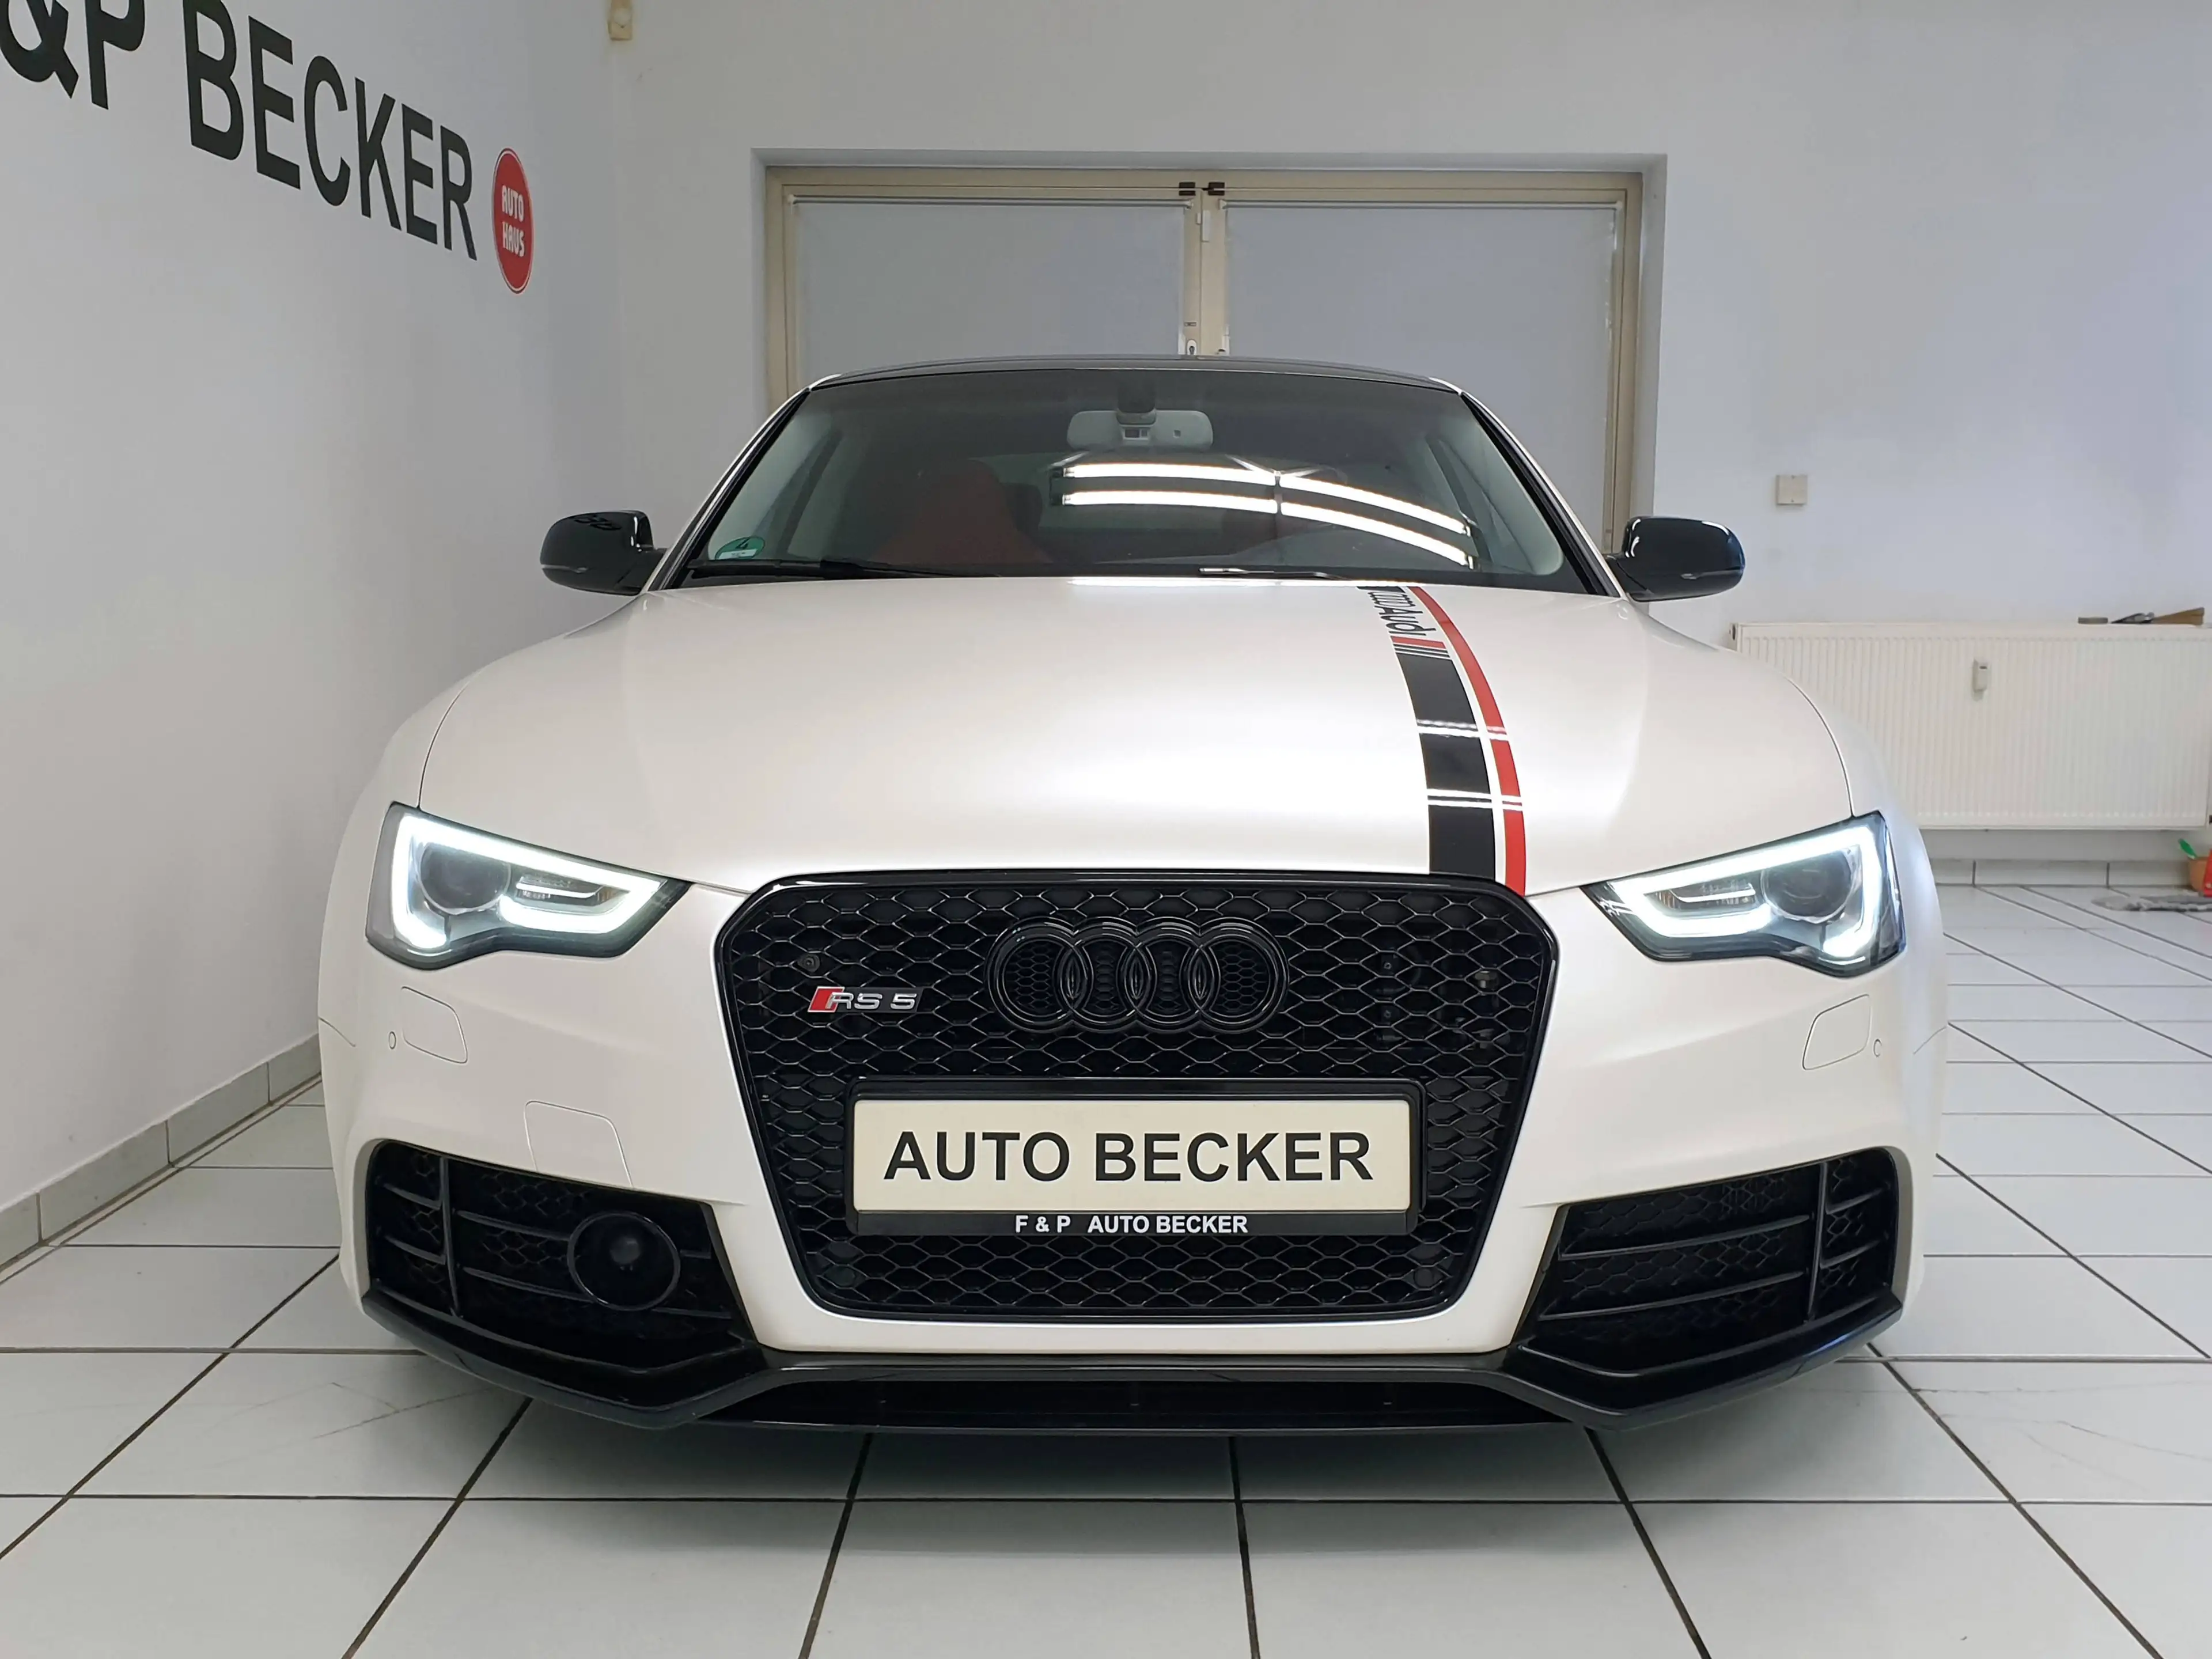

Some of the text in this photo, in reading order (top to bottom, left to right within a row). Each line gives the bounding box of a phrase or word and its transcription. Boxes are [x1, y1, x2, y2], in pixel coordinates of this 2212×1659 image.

[183, 0, 478, 261] BECKER
[502, 184, 525, 222] AUTO
[502, 221, 525, 257] HAUS
[1373, 605, 1437, 637] Audi
[824, 991, 918, 1010] RS 5
[884, 1131, 1373, 1182] AUTO BECKER
[1016, 1215, 1248, 1234] F & P AUTO BECKER
